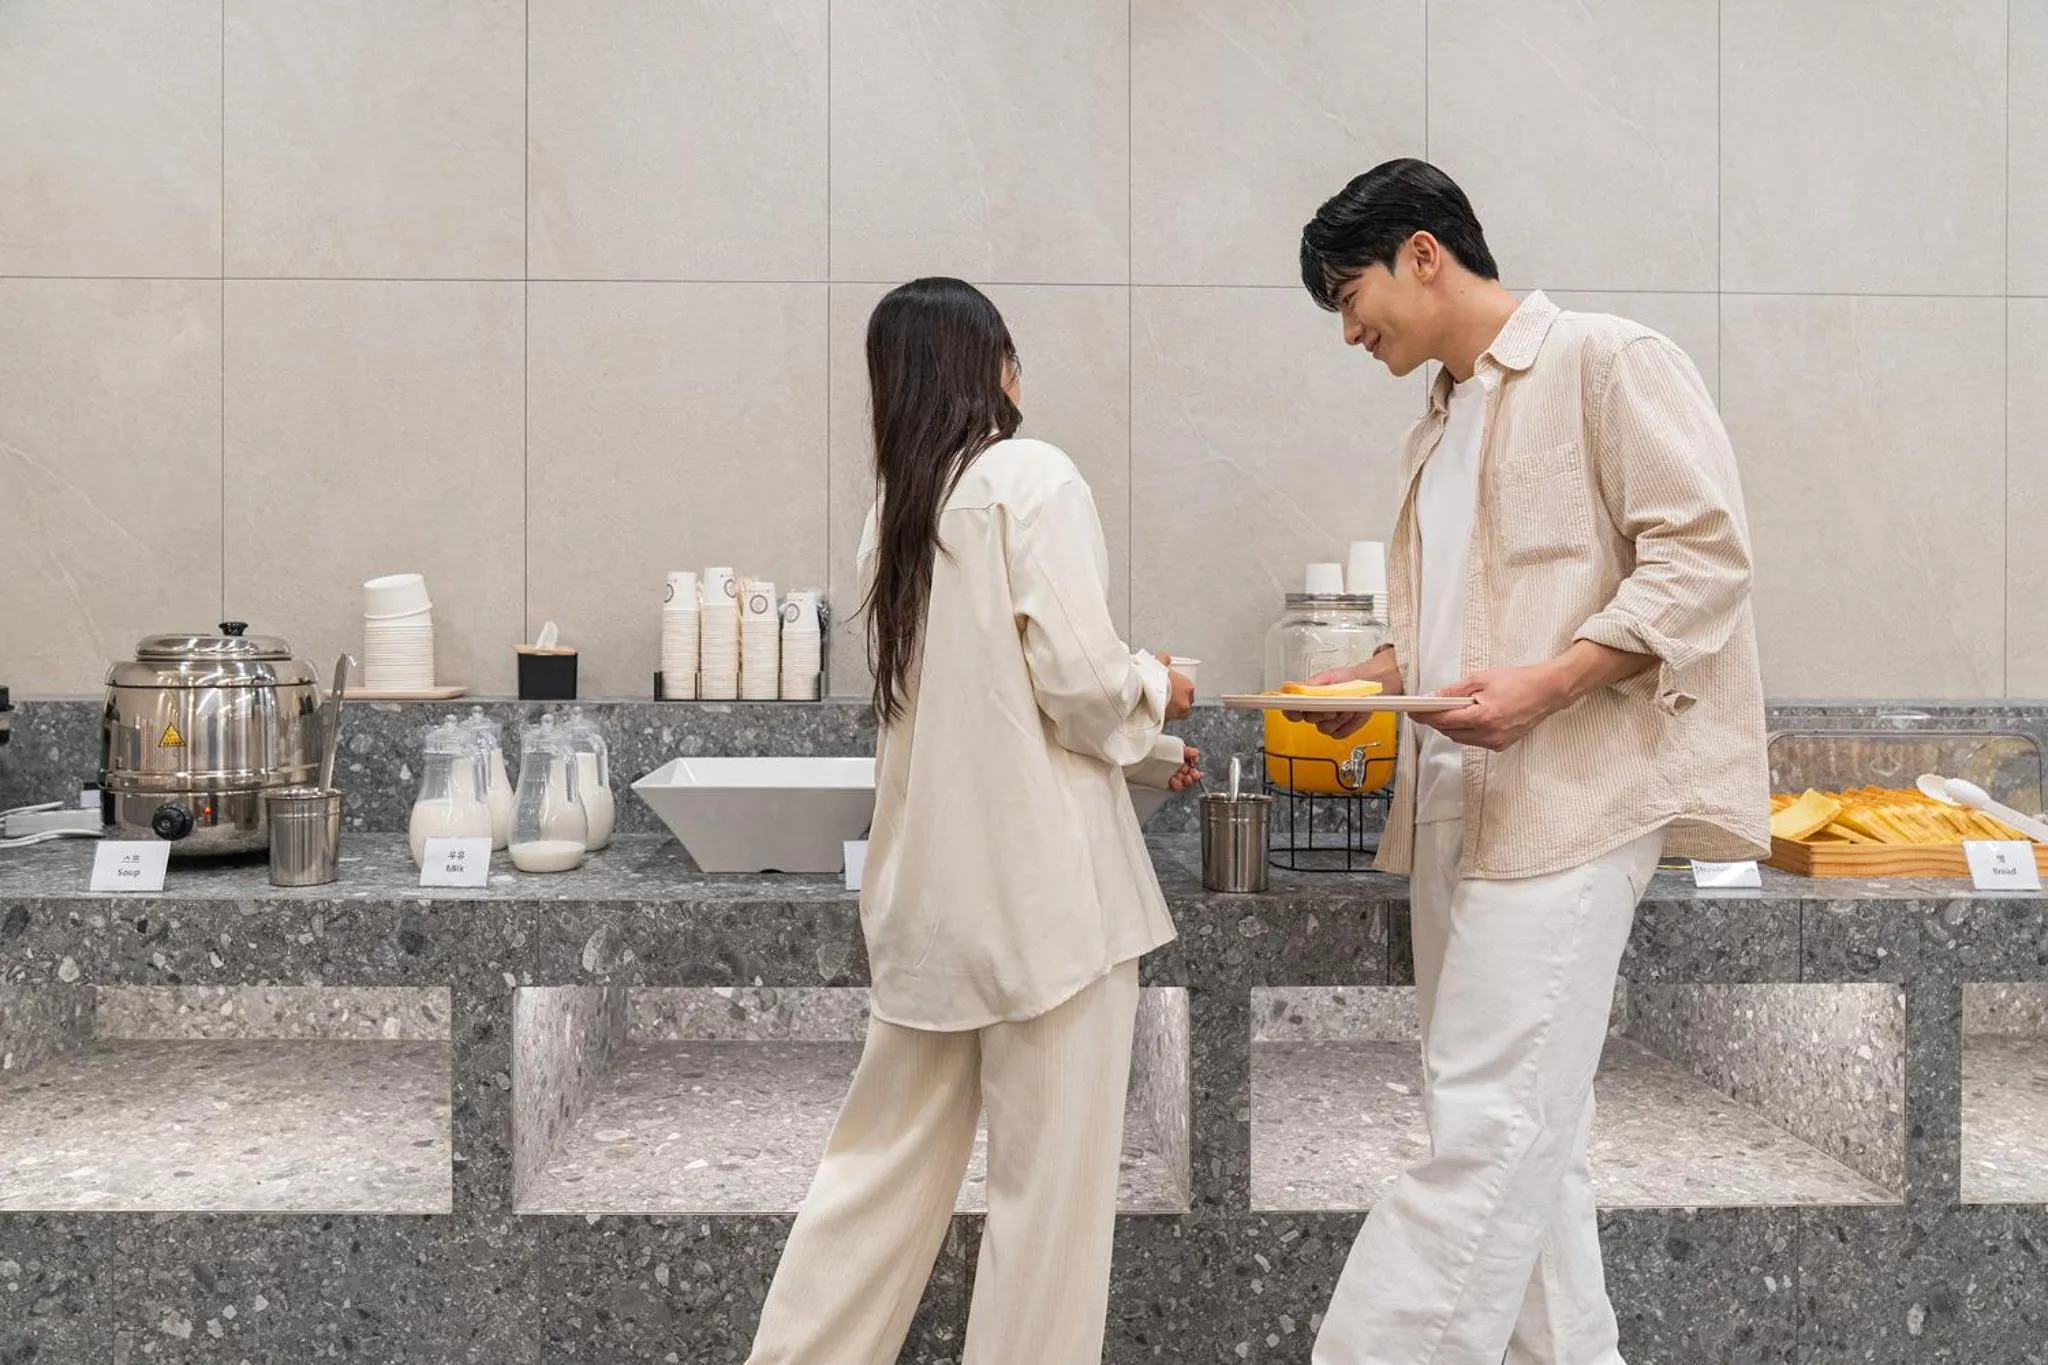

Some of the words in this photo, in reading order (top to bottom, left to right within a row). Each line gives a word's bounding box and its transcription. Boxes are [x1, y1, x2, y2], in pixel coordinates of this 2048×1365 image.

[448, 851, 465, 860] 우유
[118, 868, 141, 878] Soup
[446, 864, 465, 873] Milk
